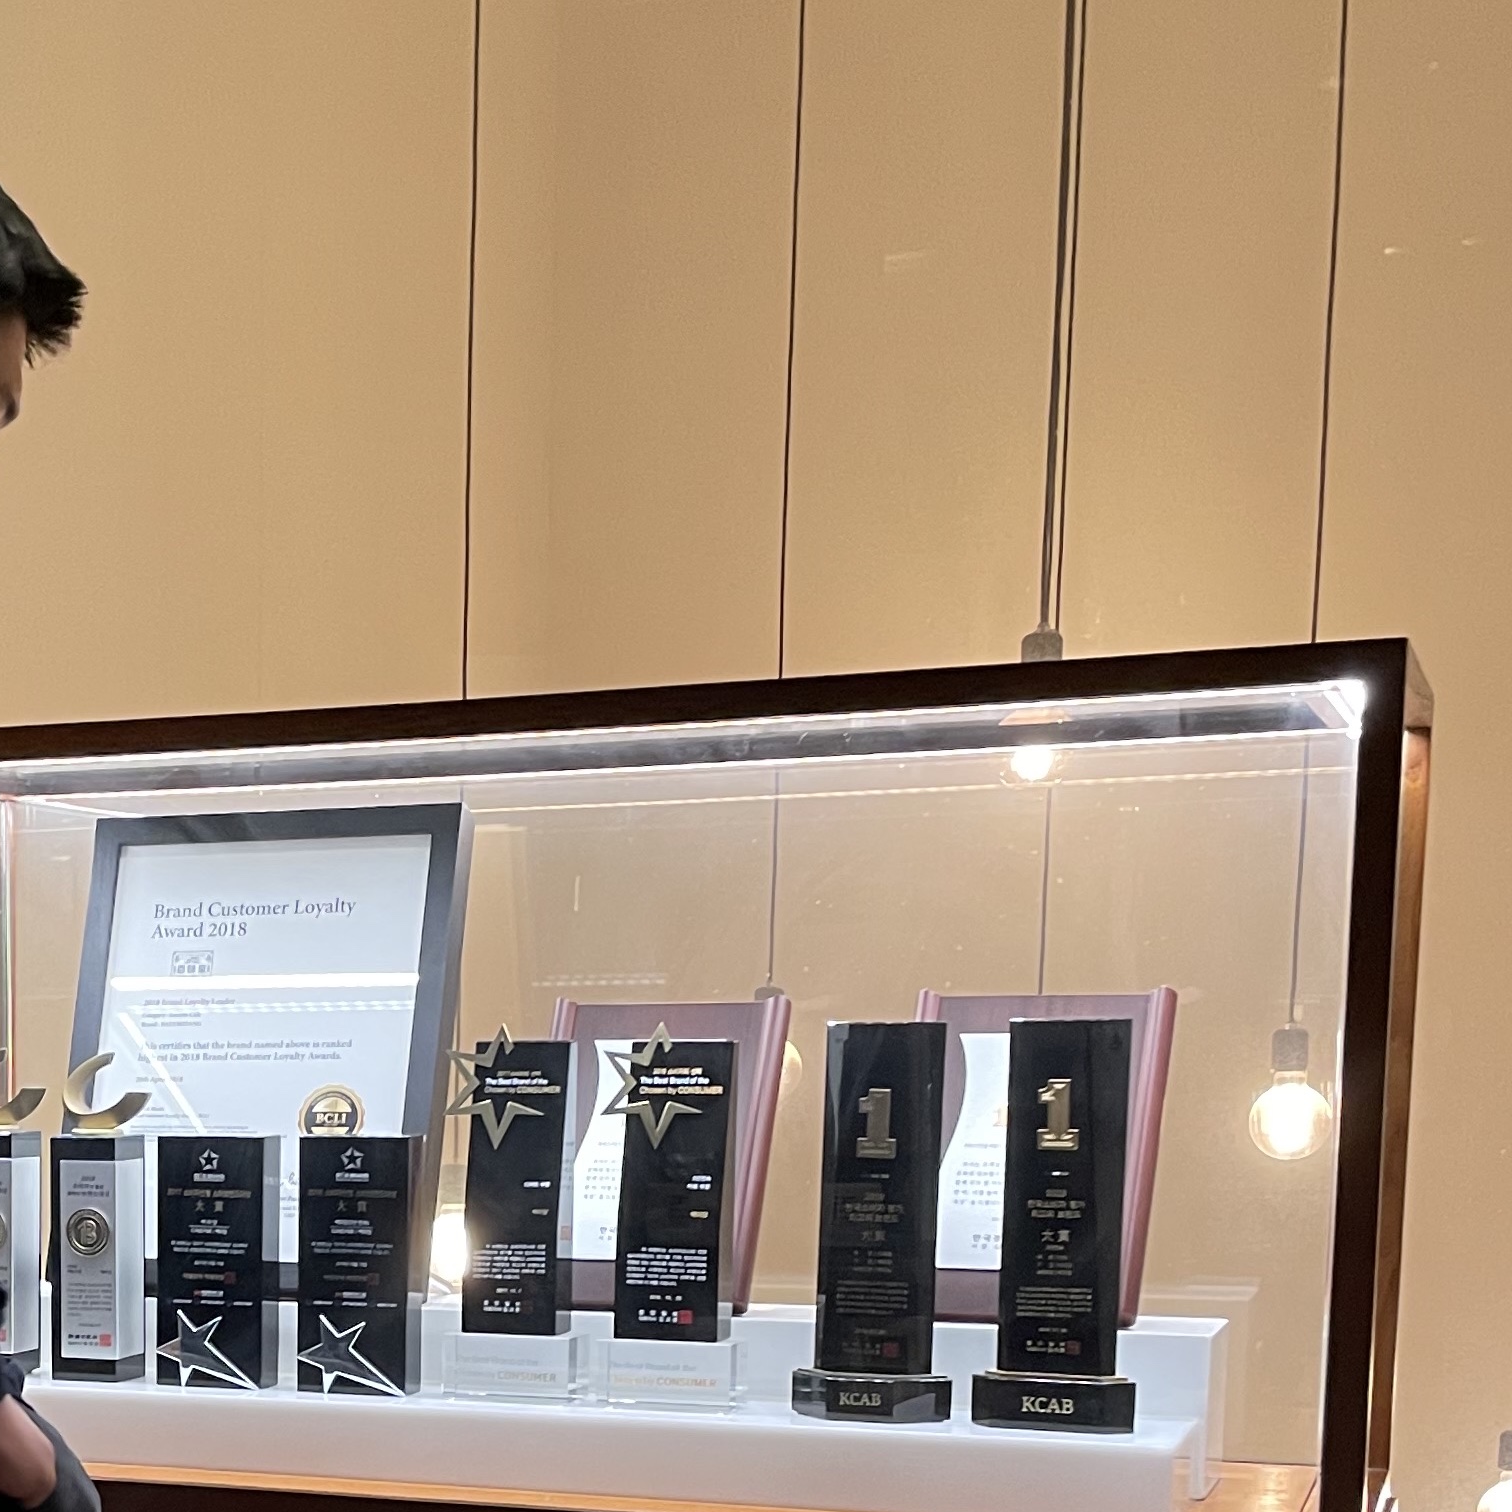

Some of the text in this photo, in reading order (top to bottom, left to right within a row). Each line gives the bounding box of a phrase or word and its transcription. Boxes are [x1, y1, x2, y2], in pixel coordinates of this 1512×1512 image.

[154, 897, 356, 918] Brand Customer Loyalty
[150, 922, 248, 939] Award 2018
[193, 1041, 209, 1050] that
[212, 1040, 225, 1049] the
[227, 1040, 252, 1049] brand
[254, 1040, 283, 1048] named
[285, 1040, 310, 1048] above
[322, 1039, 352, 1047] ranked
[138, 1053, 168, 1063] higest
[169, 1053, 178, 1061] in
[180, 1053, 200, 1061] 2018
[203, 1052, 228, 1060] Brand
[230, 1052, 271, 1060] Customer
[274, 1051, 305, 1062] Loyalty
[315, 1112, 347, 1124] BCLI
[1037, 1078, 1080, 1150] 1
[856, 1088, 897, 1159] 1
[497, 1370, 557, 1383] CONSUMER
[656, 1376, 717, 1388] CONSUMER
[839, 1391, 882, 1406] KCAB
[1021, 1396, 1075, 1414] KCAB
